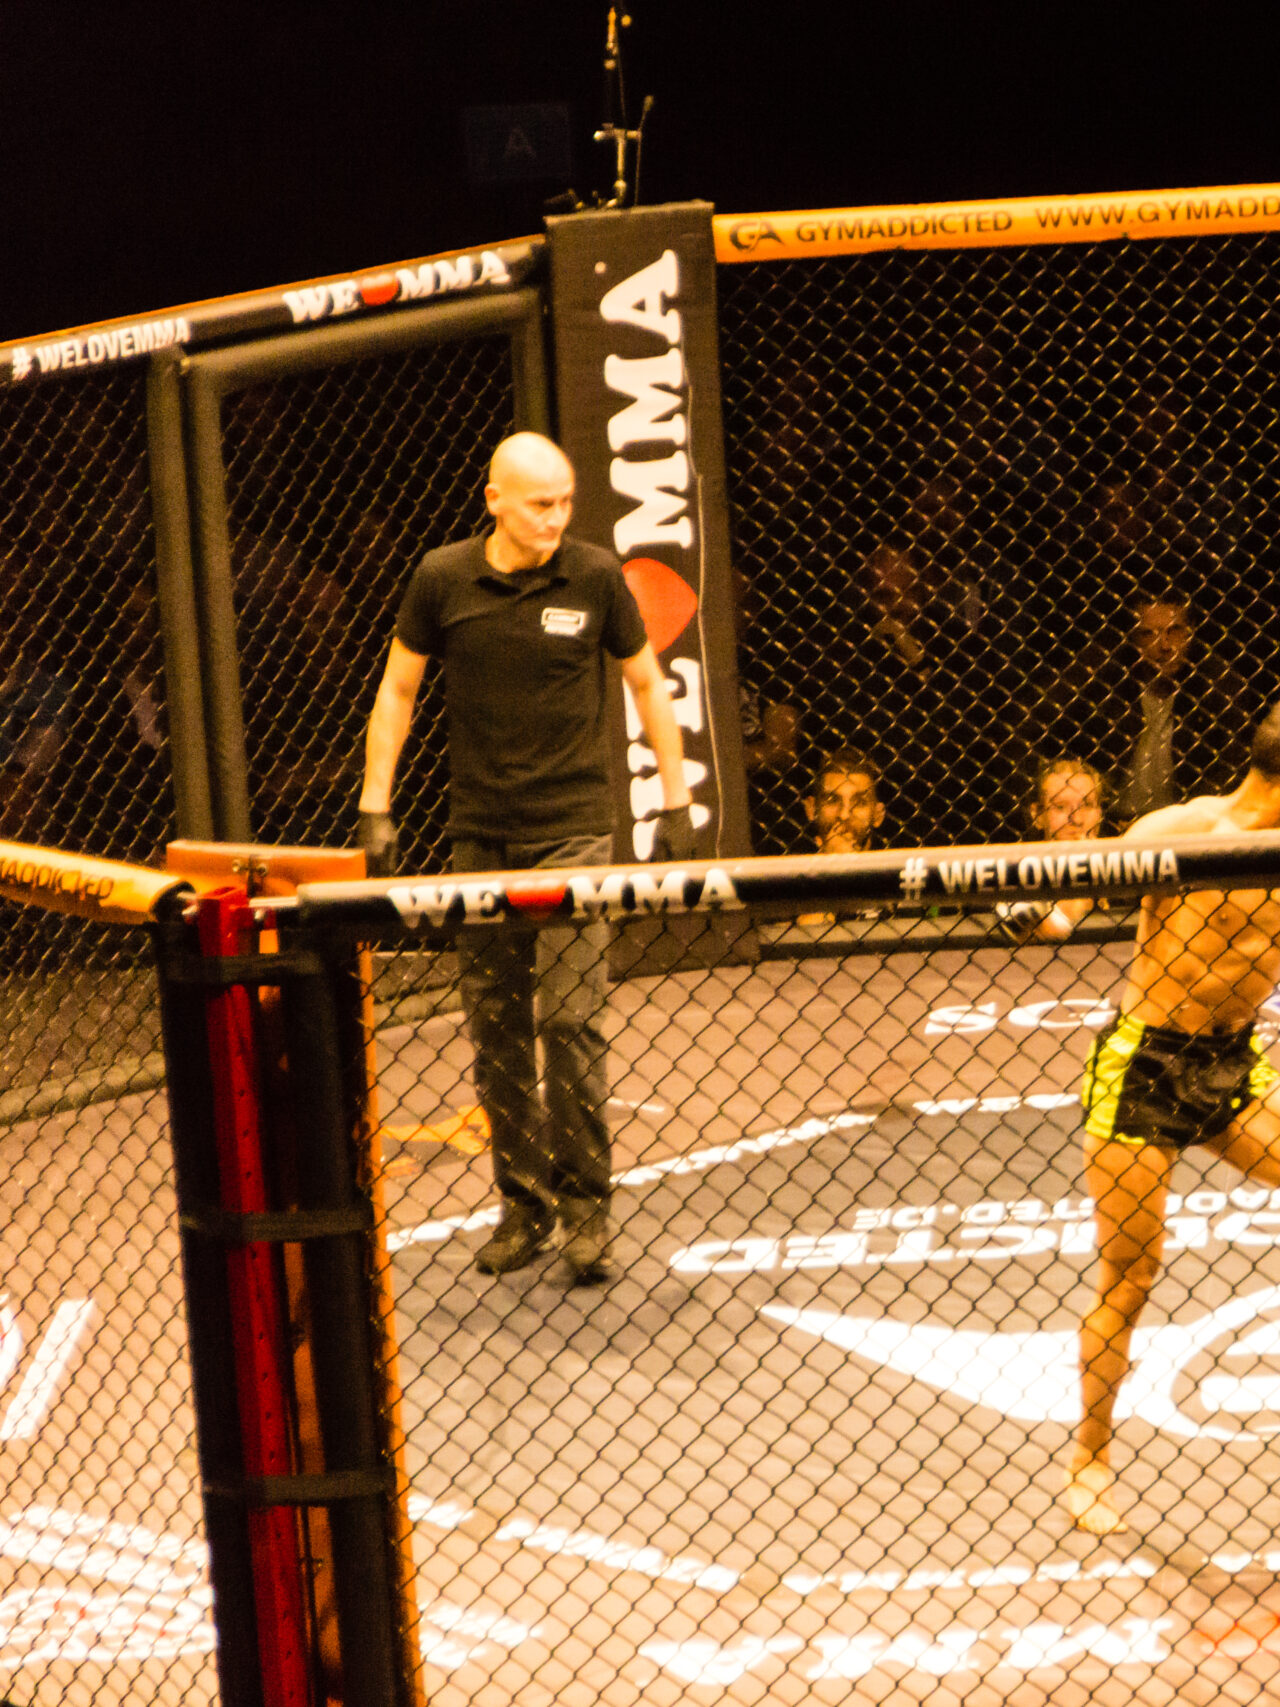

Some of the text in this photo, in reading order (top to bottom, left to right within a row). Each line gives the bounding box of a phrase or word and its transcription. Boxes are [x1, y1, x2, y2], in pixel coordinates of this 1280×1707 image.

[795, 210, 1013, 243] GYMADDICTED
[282, 250, 511, 324] WE MMA
[600, 249, 694, 555] MMA
[0, 857, 115, 900] ADDICTED
[388, 869, 745, 928] WE MMA
